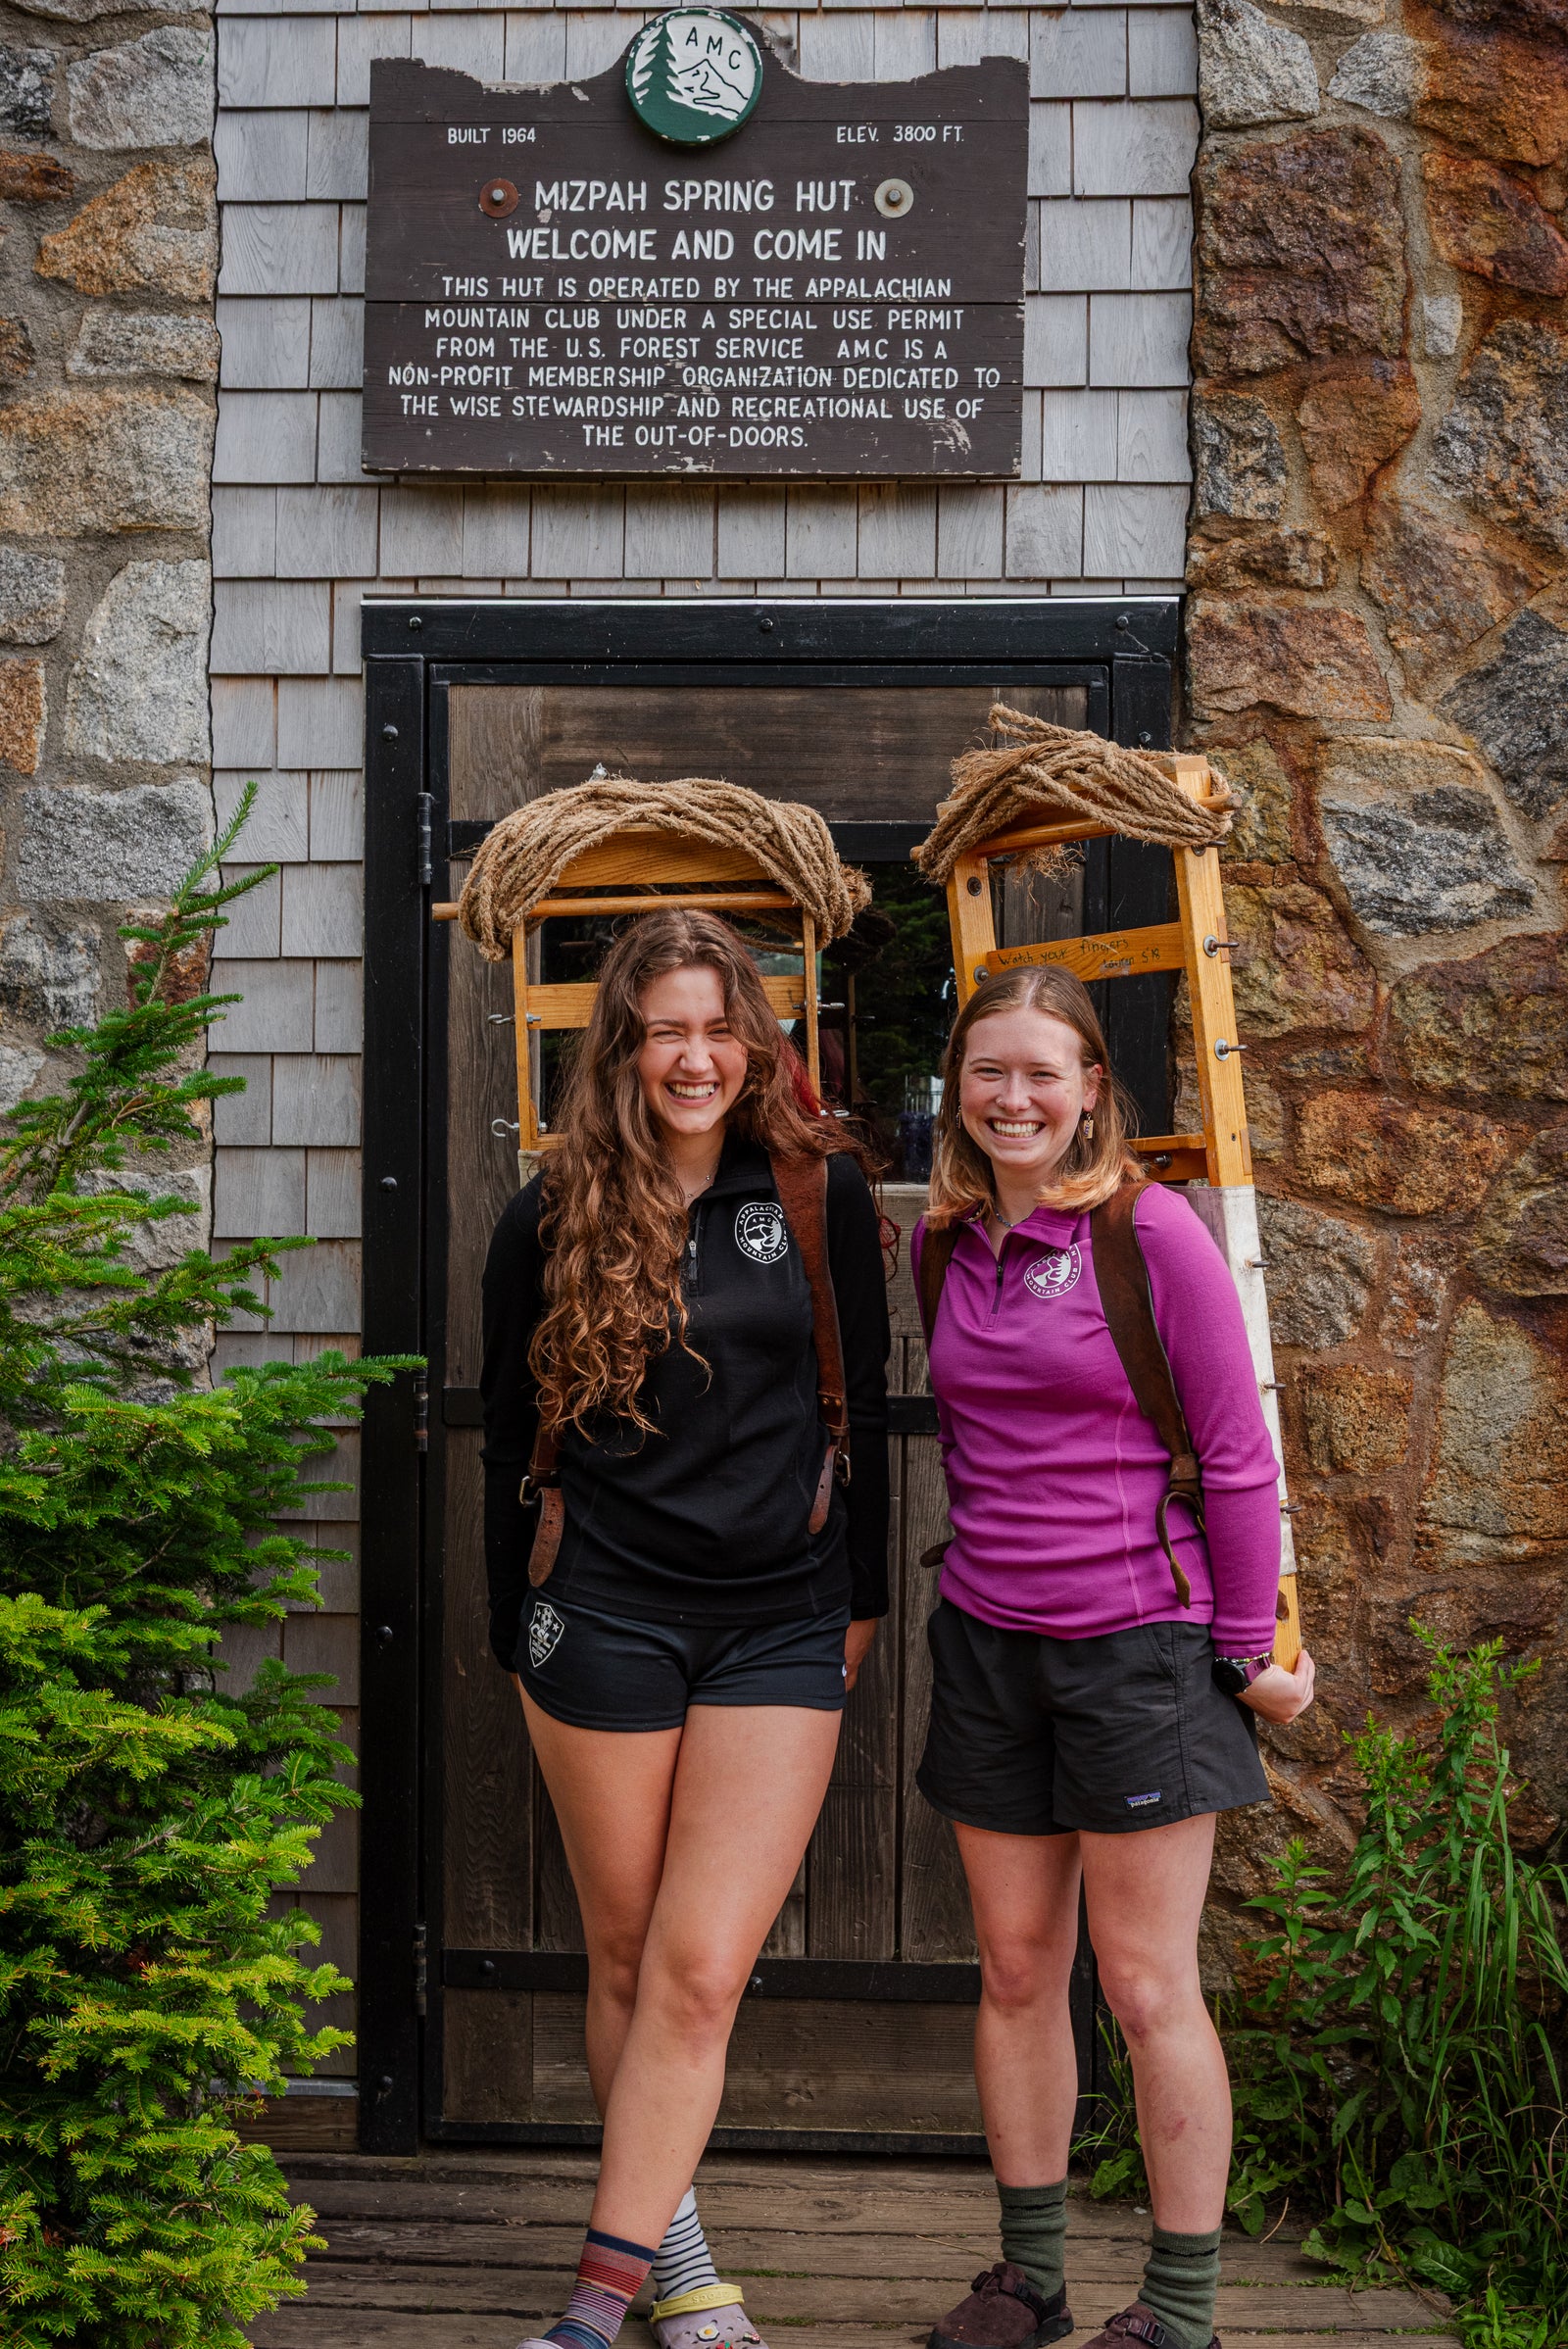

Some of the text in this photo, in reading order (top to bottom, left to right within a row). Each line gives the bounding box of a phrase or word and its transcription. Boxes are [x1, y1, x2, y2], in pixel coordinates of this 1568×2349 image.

[685, 25, 742, 71] AMC
[447, 126, 536, 145] BUILT 1964
[836, 124, 963, 143] ELEV. 3800 FT.
[534, 179, 857, 213] MIZPAH SPRING HUT
[506, 227, 886, 262] WELCOME AND COME IN
[441, 275, 952, 299] THIS HUT IS OPERATED BY THE APPALACHIAN
[424, 307, 964, 330] MOUNTAIN CLUB UNDER A SPECIAL USE PERMIT
[436, 336, 948, 361] FROM THE U.S. FOREST SERVICE AMC IS A
[388, 365, 1001, 390] NON-PROFIT MEMBERSHIP ORGANIZATION DEDICATED TO
[400, 394, 985, 420] THE WISE STEWARDSHIP AND RECREATIONAL USE OF
[581, 424, 808, 448] THE OUT-OF-DOORS.
[997, 951, 1034, 965] Watch
[1080, 938, 1129, 955] fingers
[739, 1237, 777, 1261] MOUNTAIN
[1026, 1267, 1078, 1295] MOUNTAIN CLUB
